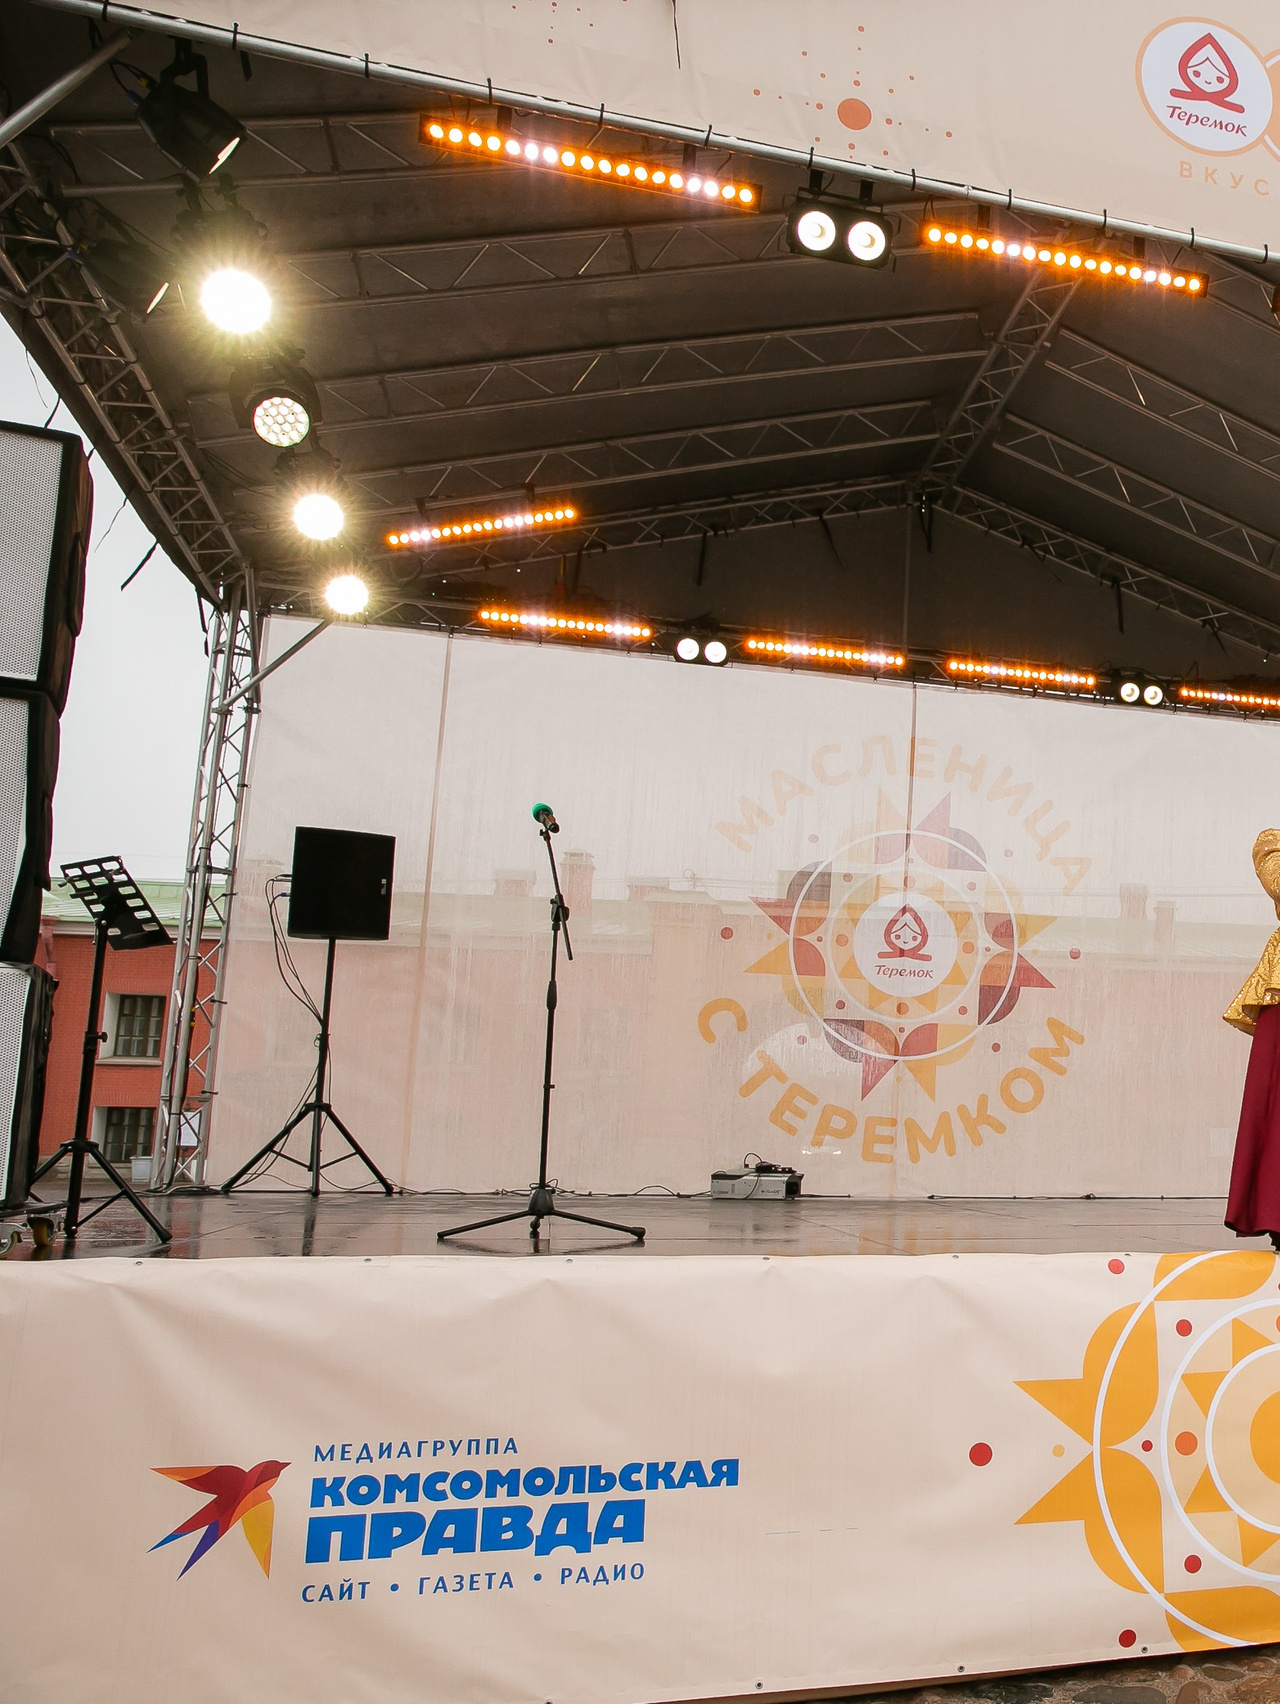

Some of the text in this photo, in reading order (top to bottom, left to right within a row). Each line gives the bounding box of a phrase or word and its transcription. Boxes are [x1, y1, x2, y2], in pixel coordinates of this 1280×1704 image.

[1166, 105, 1247, 137] Теремок
[715, 735, 1093, 896] МАСЛЕНИЦА
[875, 964, 934, 979] Теремок
[697, 997, 1086, 1165] С ТЕРЕМКОМ
[313, 1436, 519, 1465] МЕДИАГРУППА
[309, 1458, 740, 1508] КОМСОМОЛЬСКАЯ
[304, 1499, 647, 1564] ПРАВДА
[301, 1562, 646, 1604] САЙТ ГАЗЕТА РАДИО
